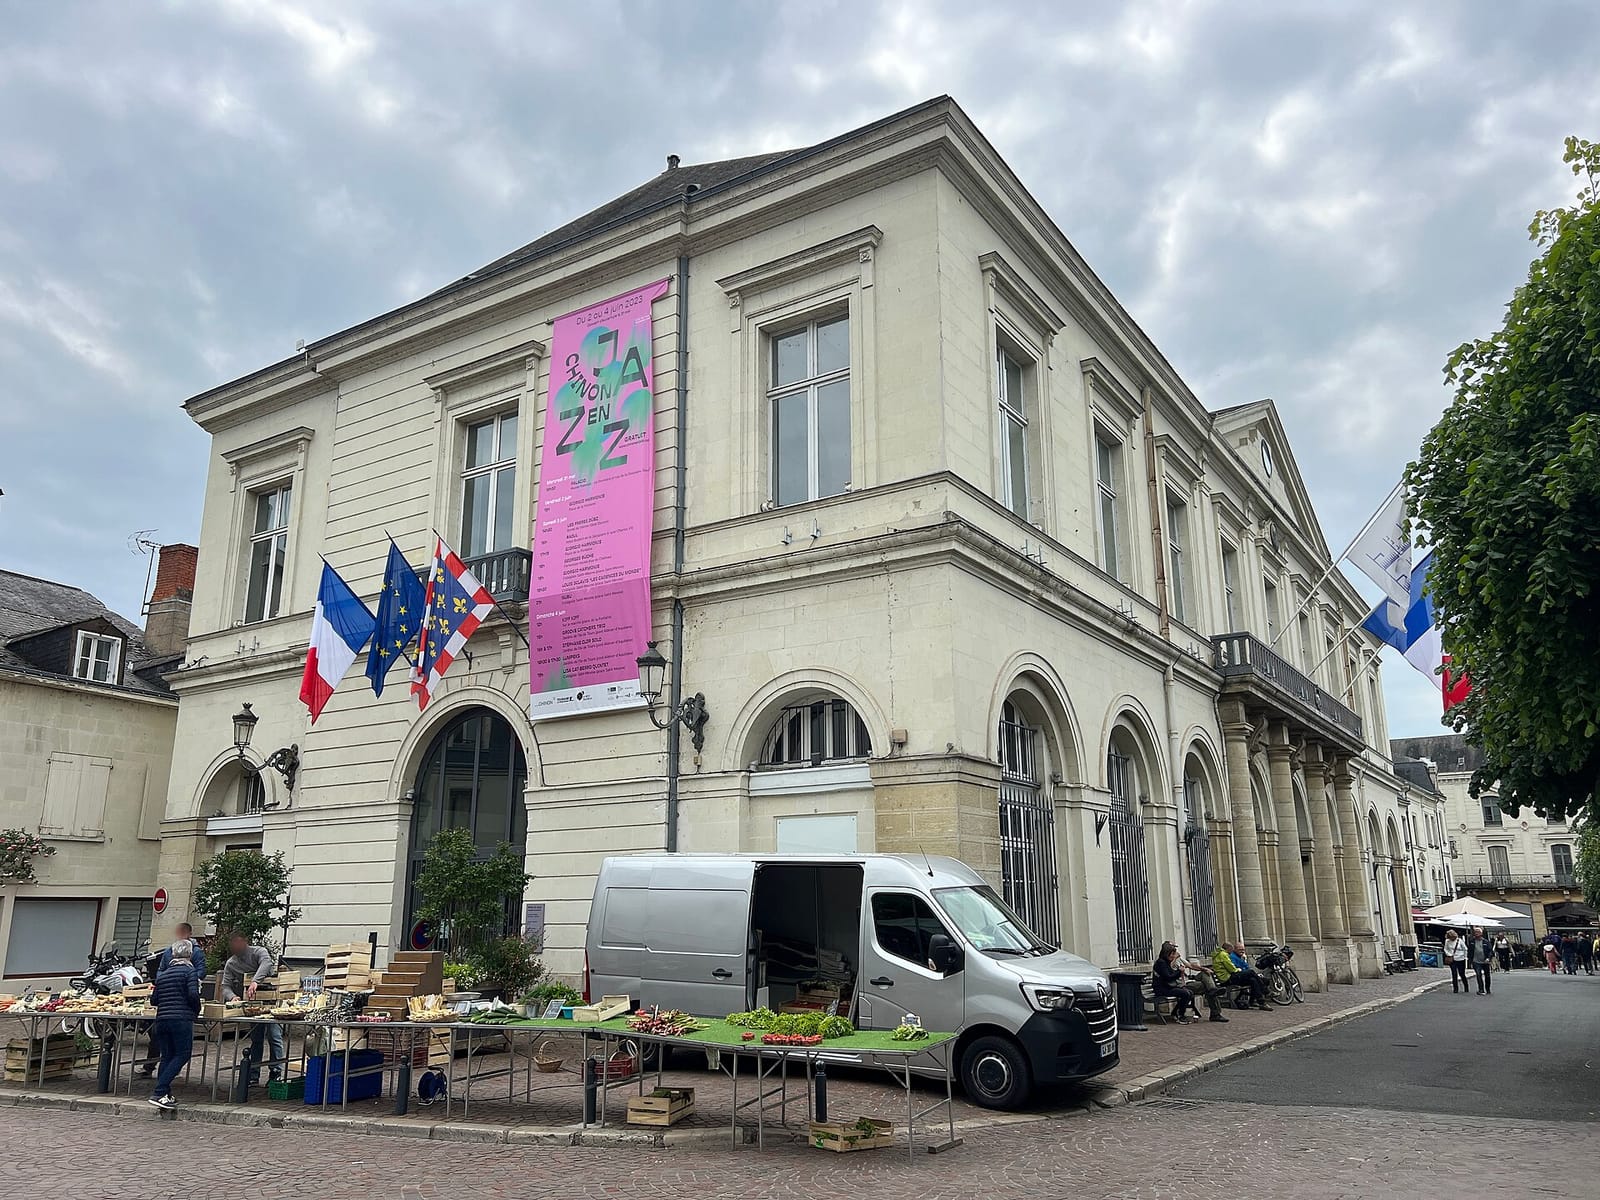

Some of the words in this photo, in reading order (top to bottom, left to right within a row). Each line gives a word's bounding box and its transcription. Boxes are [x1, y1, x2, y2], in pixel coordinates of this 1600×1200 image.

[577, 317, 586, 326] Du
[588, 314, 592, 322] 2
[594, 311, 603, 320] au
[610, 303, 624, 315] juin
[625, 295, 643, 308] 2023
[566, 353, 612, 401] CHINON
[588, 403, 610, 426] EN
